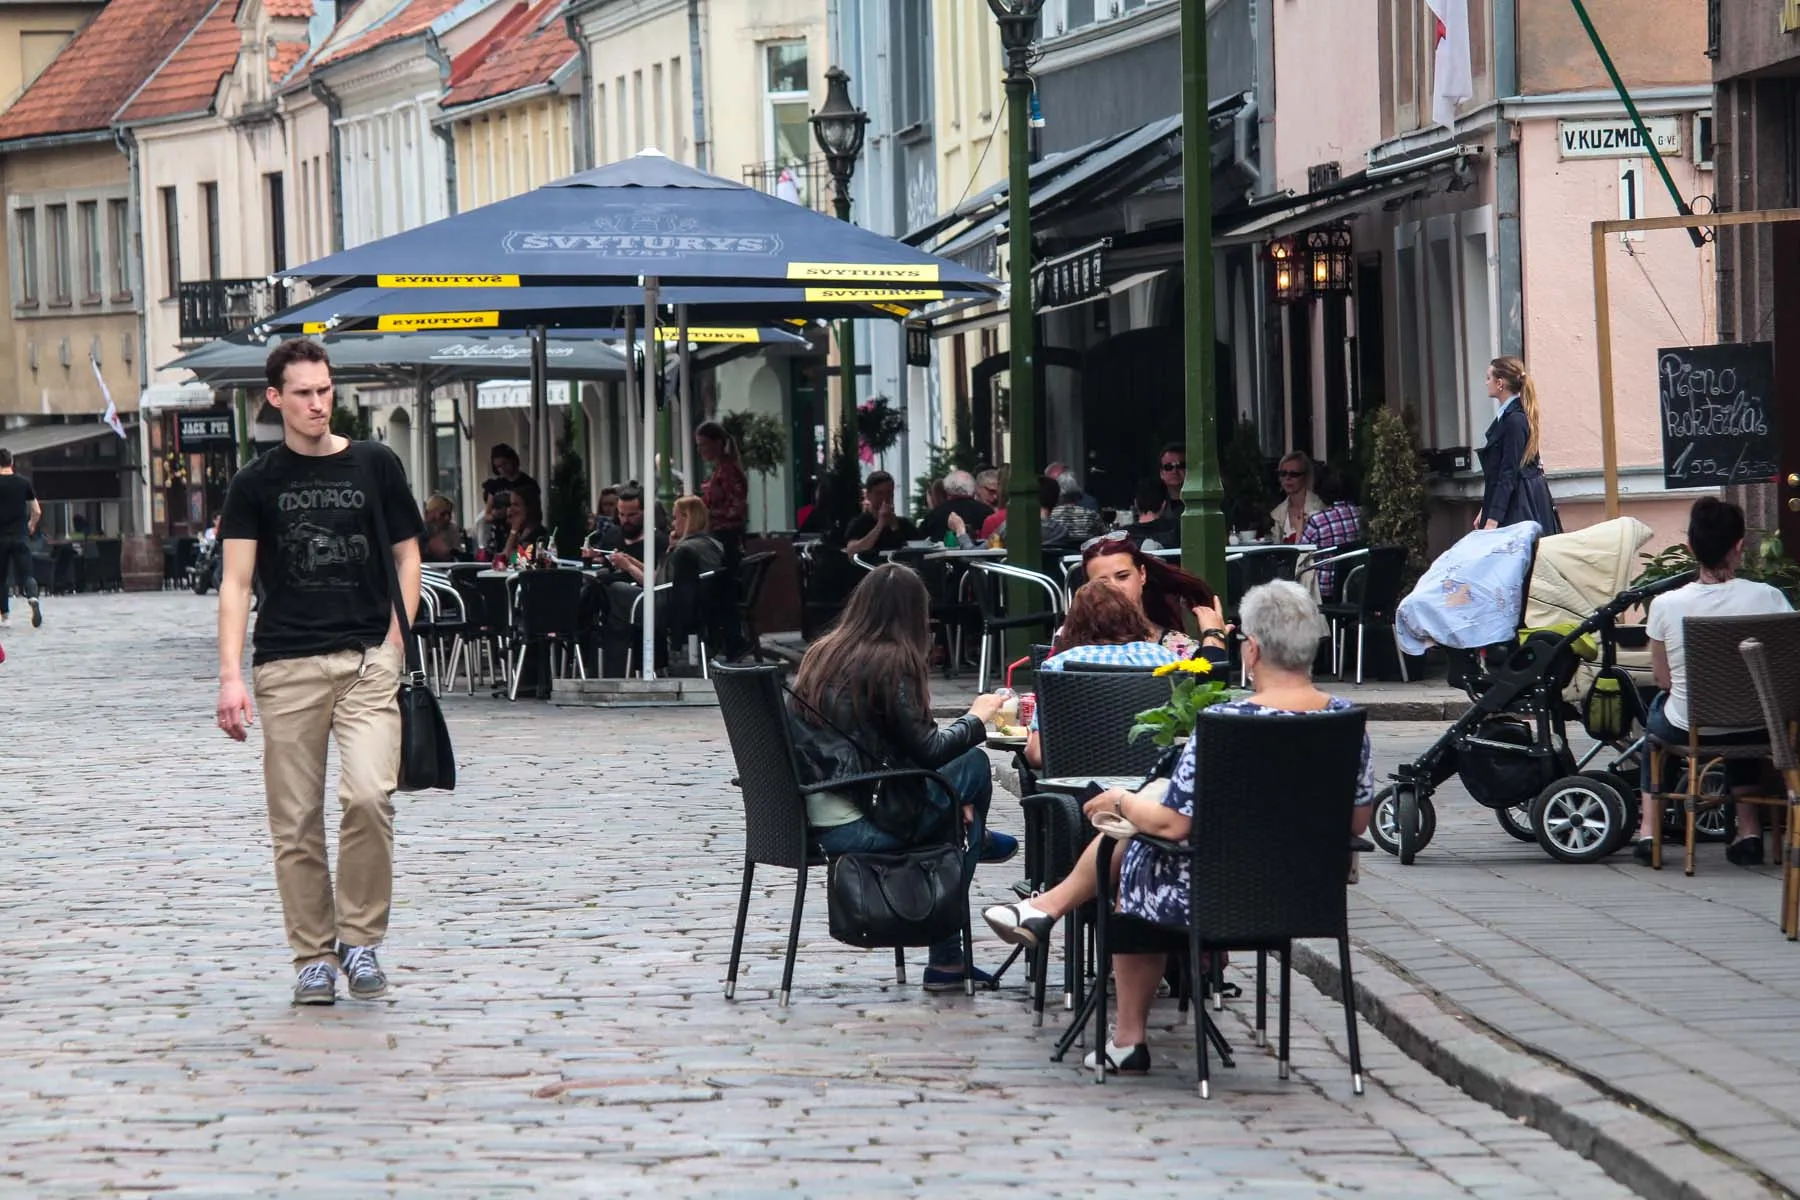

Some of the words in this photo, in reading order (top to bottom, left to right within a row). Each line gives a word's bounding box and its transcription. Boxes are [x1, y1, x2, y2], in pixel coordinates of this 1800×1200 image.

[1621, 169, 1636, 220] 1
[182, 422, 206, 434] JACK
[210, 422, 229, 433] PUB
